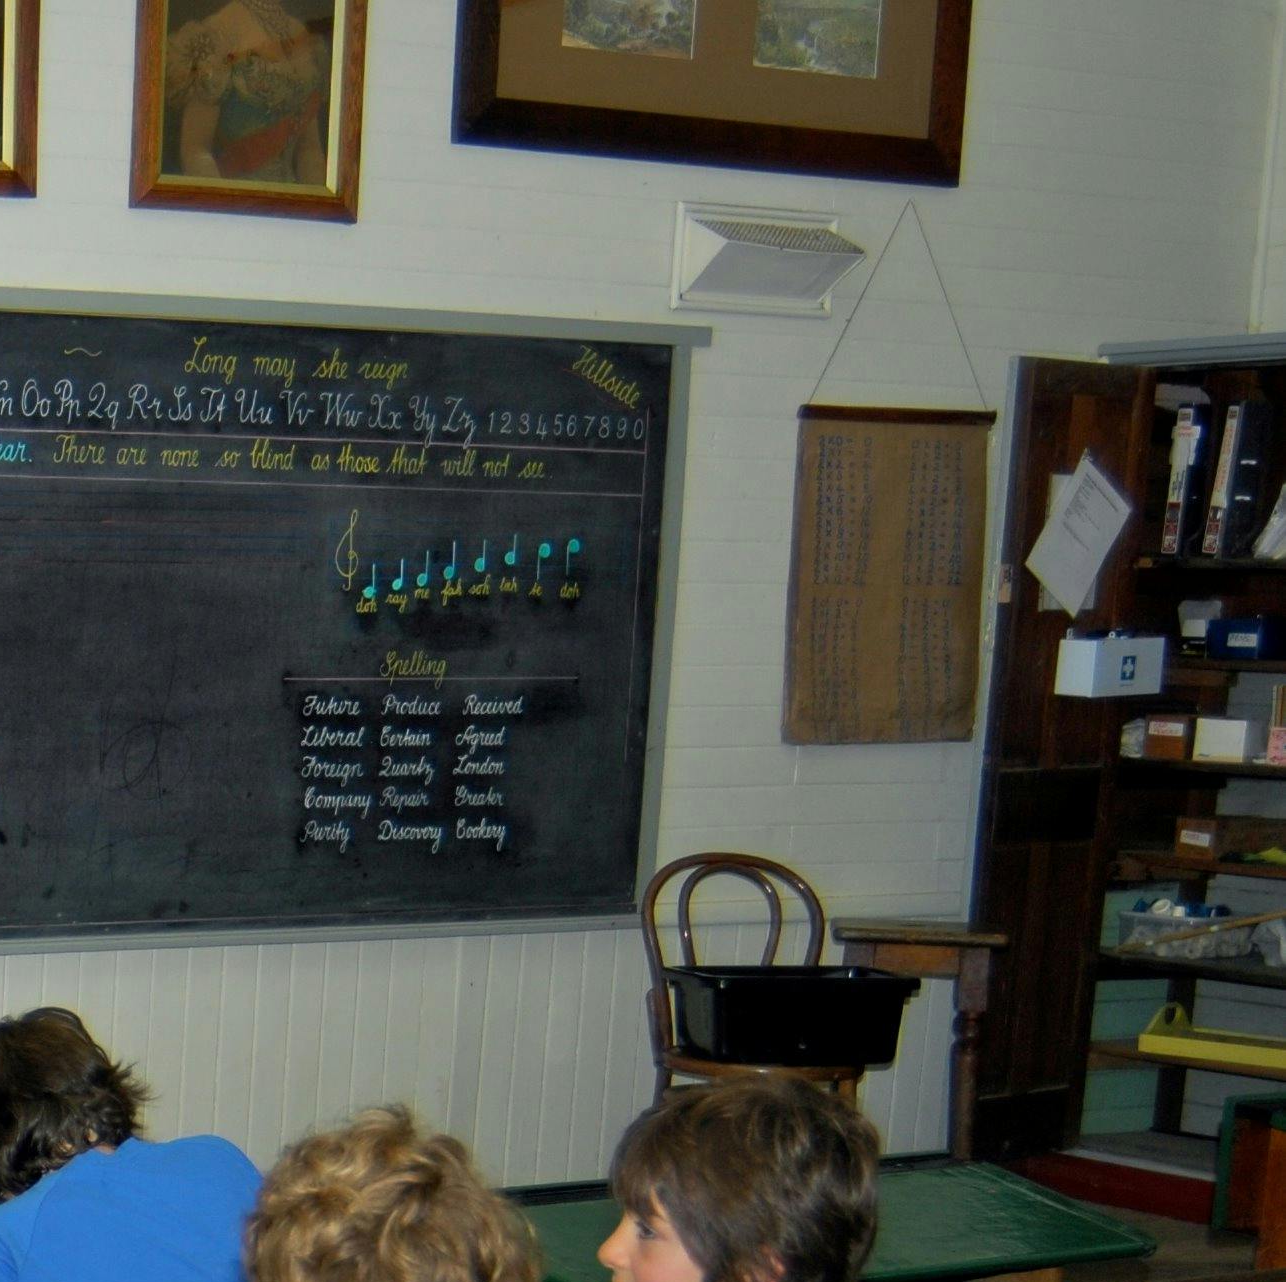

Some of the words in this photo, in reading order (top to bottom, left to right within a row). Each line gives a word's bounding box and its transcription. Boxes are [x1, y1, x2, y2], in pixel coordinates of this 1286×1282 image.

[184, 336, 237, 385] Long
[253, 358, 296, 388] may
[312, 348, 347, 380] she
[358, 355, 408, 390] reign
[572, 345, 640, 409] Hillside
[21, 378, 50, 418] Oo
[54, 379, 80, 425] Pp
[88, 382, 119, 431] Qq
[127, 383, 163, 420] Rr
[169, 386, 192, 423] Ss
[200, 387, 226, 424] Tt
[234, 389, 273, 425] Uu
[279, 390, 315, 426] Vv
[320, 392, 362, 427] Ww
[368, 393, 402, 431] Xx
[408, 395, 436, 449] Yy
[441, 397, 477, 449] Zz
[53, 434, 106, 465] There
[116, 446, 147, 465] are
[161, 449, 199, 469] none
[214, 450, 241, 469] so
[251, 438, 296, 471] blind
[311, 453, 330, 471] as
[337, 443, 381, 474] those
[386, 444, 427, 475] that
[440, 449, 477, 478] will
[482, 453, 511, 479] not
[356, 598, 377, 613] doh
[380, 650, 448, 689] Spelling
[303, 695, 361, 716] Future
[381, 694, 442, 715] Produce
[463, 694, 523, 715] Received
[300, 725, 365, 747] Liberal
[380, 725, 431, 746] Certain
[455, 724, 505, 754] Agreed
[301, 755, 363, 787] Foreign
[379, 755, 435, 785] Quartz
[453, 754, 505, 775] London
[304, 786, 372, 819] Company
[379, 785, 428, 814] Repair
[454, 785, 503, 806] Greater
[300, 820, 351, 853] Purity
[378, 819, 442, 853] Discovery
[456, 817, 506, 852] Cookery
